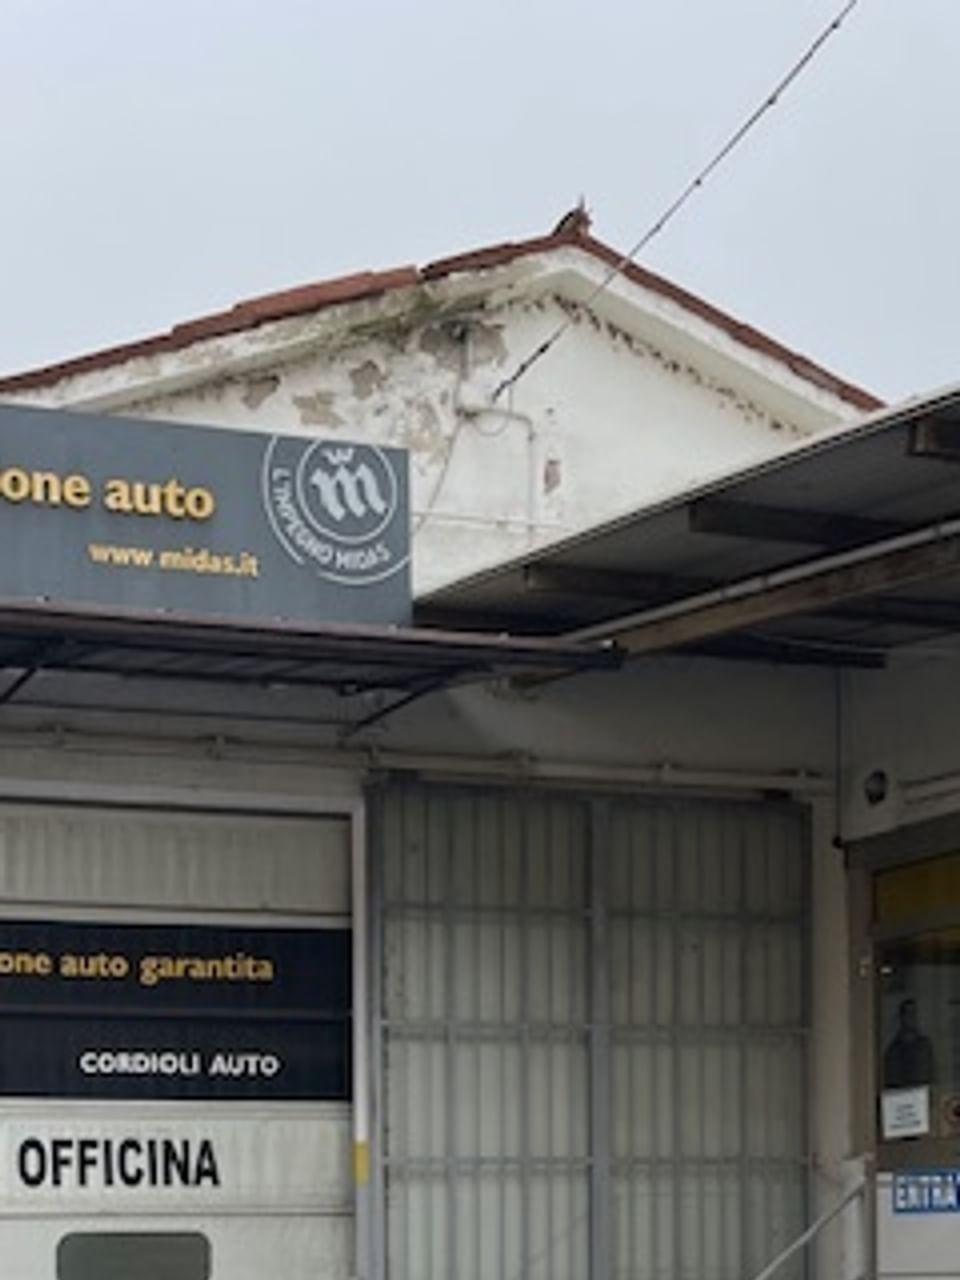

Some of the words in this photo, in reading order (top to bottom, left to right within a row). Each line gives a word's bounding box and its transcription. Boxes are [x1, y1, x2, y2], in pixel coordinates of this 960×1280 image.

[103, 476, 216, 523] auto
[88, 542, 259, 578] wwwmidas.it
[59, 952, 129, 977] auto
[139, 952, 274, 985] garantita
[79, 1052, 200, 1075] CORDIOLI
[207, 1054, 280, 1076] AUTO
[17, 1137, 221, 1187] OFFICINA
